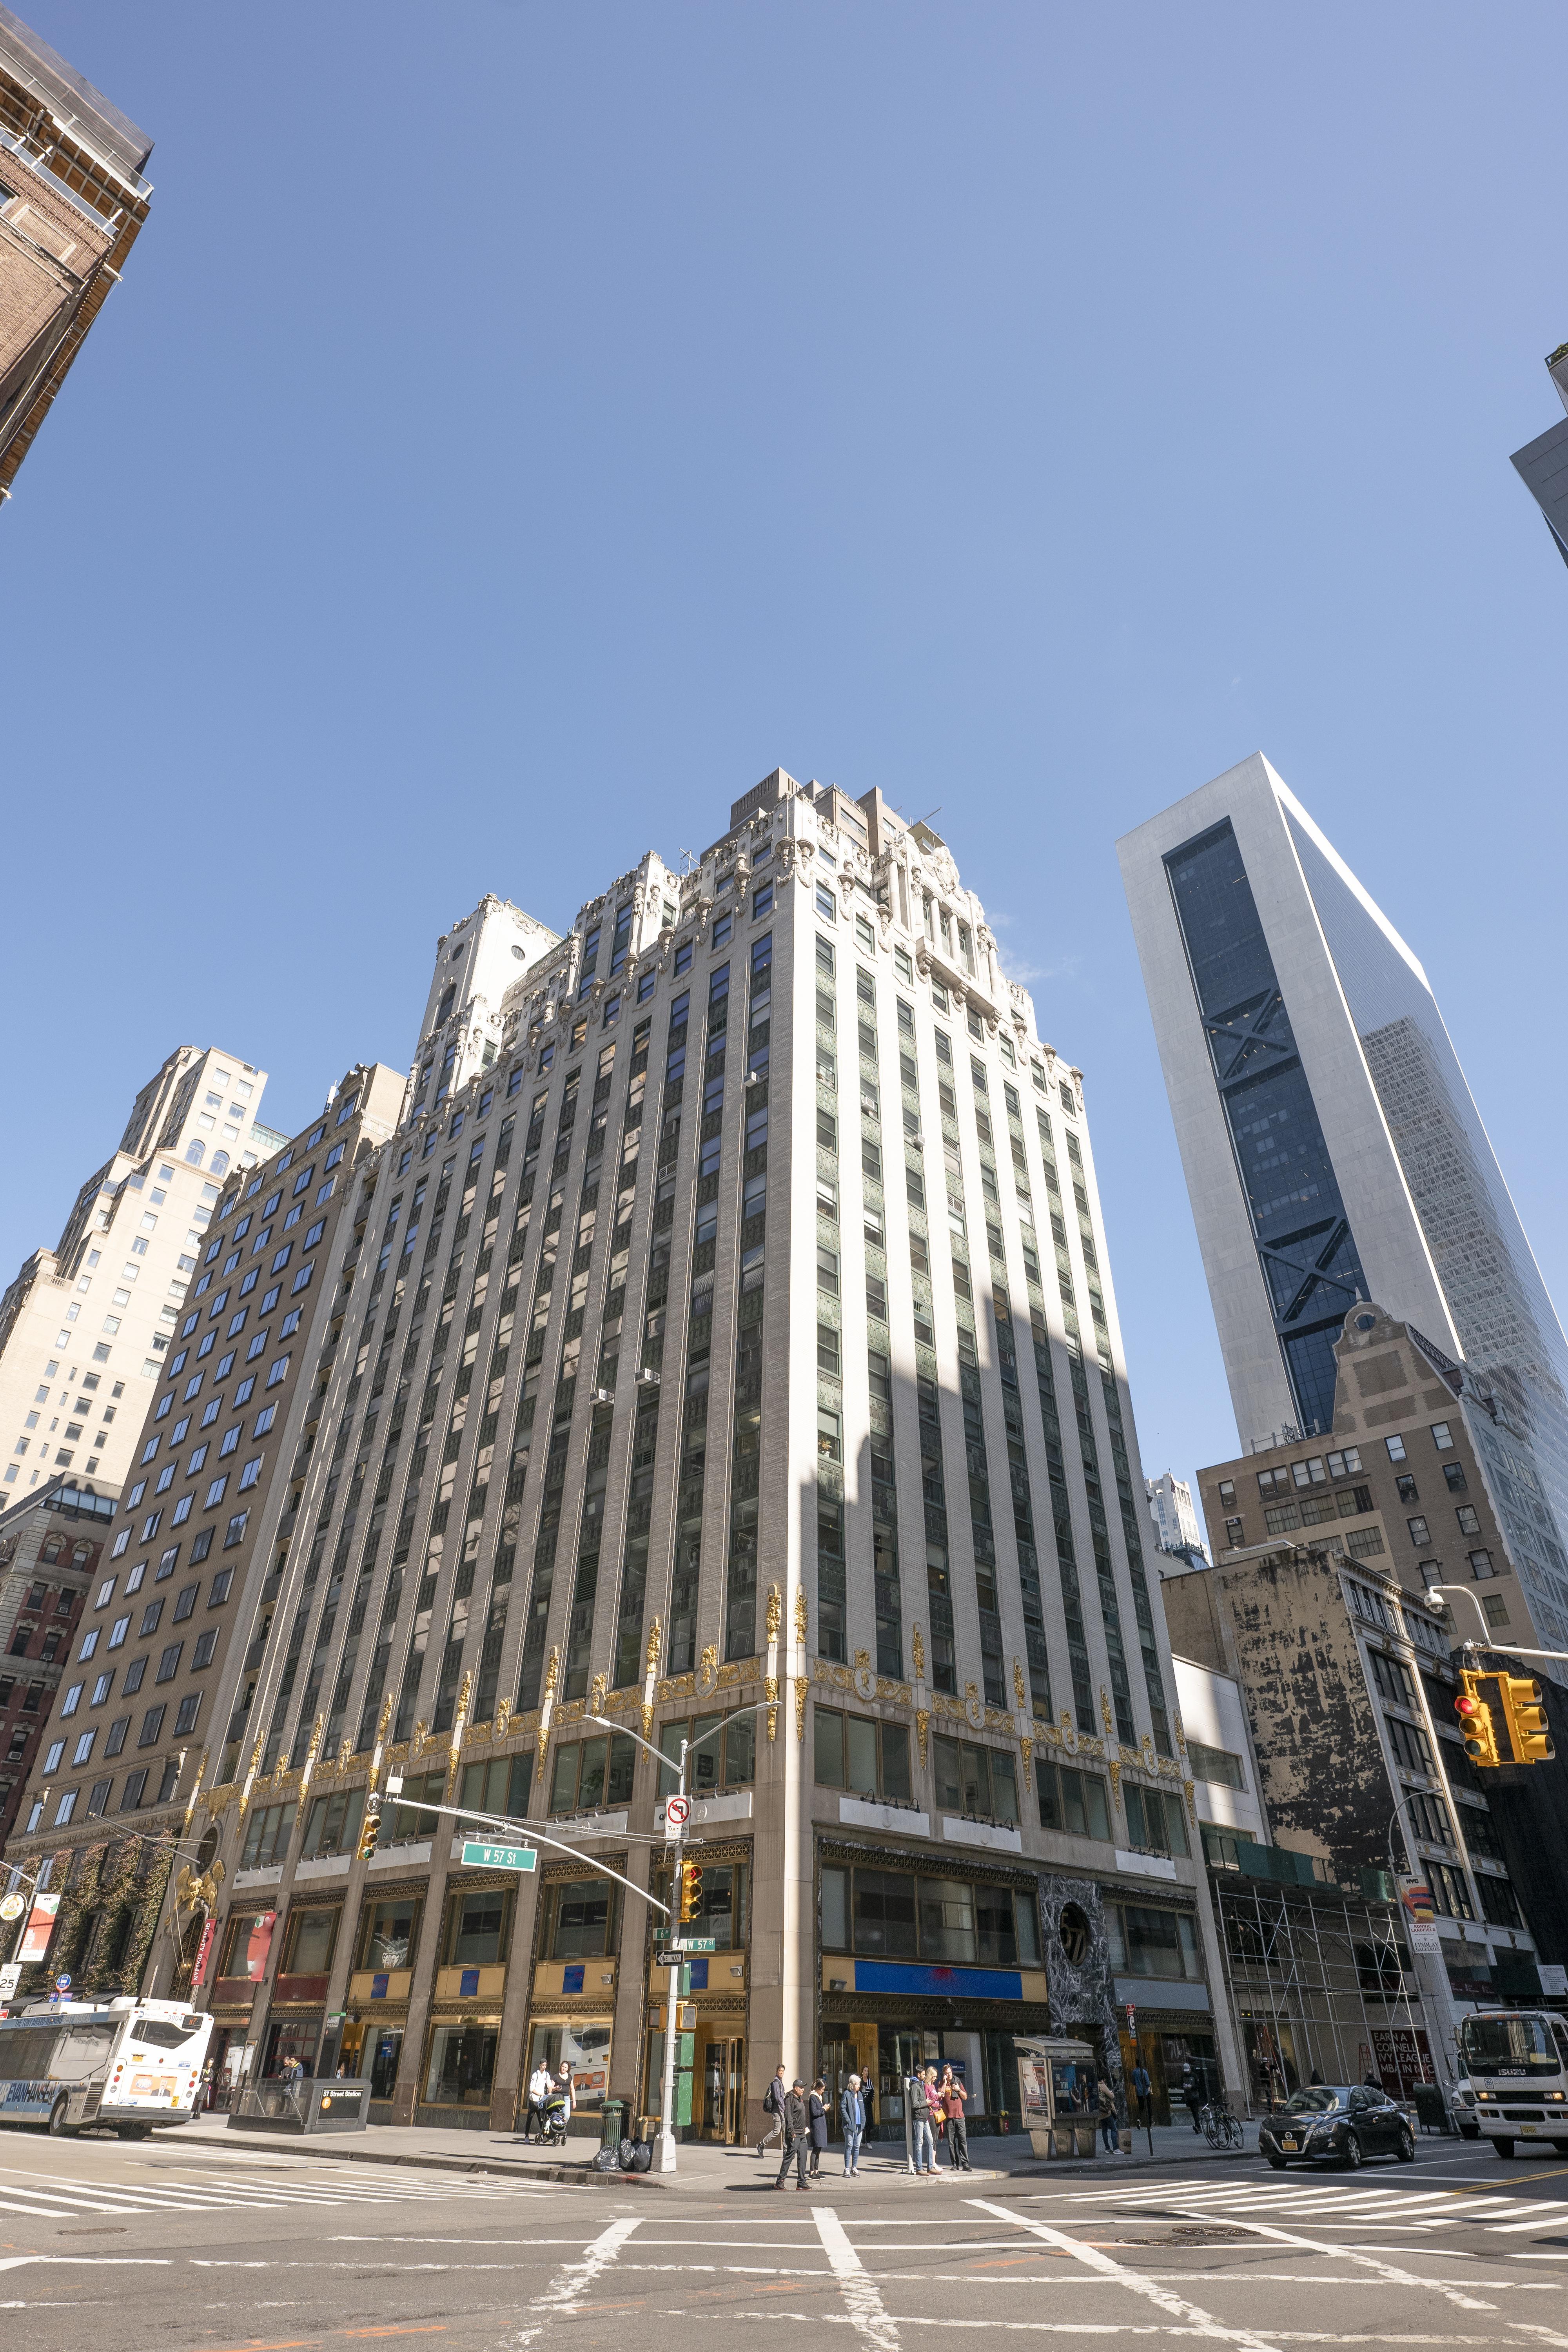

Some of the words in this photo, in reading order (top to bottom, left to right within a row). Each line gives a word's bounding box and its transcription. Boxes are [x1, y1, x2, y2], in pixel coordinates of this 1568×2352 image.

[484, 1849, 491, 1861] W
[493, 1850, 505, 1863] 57
[507, 1851, 517, 1864] St
[200, 1923, 211, 1952] QUALITY
[661, 1930, 664, 1938] 6
[688, 1940, 693, 1949] W
[698, 1940, 707, 1949] 57
[193, 1953, 203, 1980] ITALIAN
[0, 1979, 15, 1988] 25
[21, 2018, 32, 2026] TONY
[31, 2016, 64, 2026] AWARD-WINNING
[62, 2015, 74, 2024] BEST
[73, 2013, 91, 2023] MUSICAL
[1374, 2033, 1398, 2041] EARN
[1401, 2033, 1407, 2041] A
[1376, 2043, 1417, 2052] CORNELL
[1378, 2053, 1392, 2062] IVY
[1402, 2064, 1412, 2073] IN
[1414, 2064, 1435, 2074] NC
[0, 2083, 11, 2102] AR
[6, 2083, 29, 2102] EVAN
[24, 2083, 55, 2103] HANSEN
